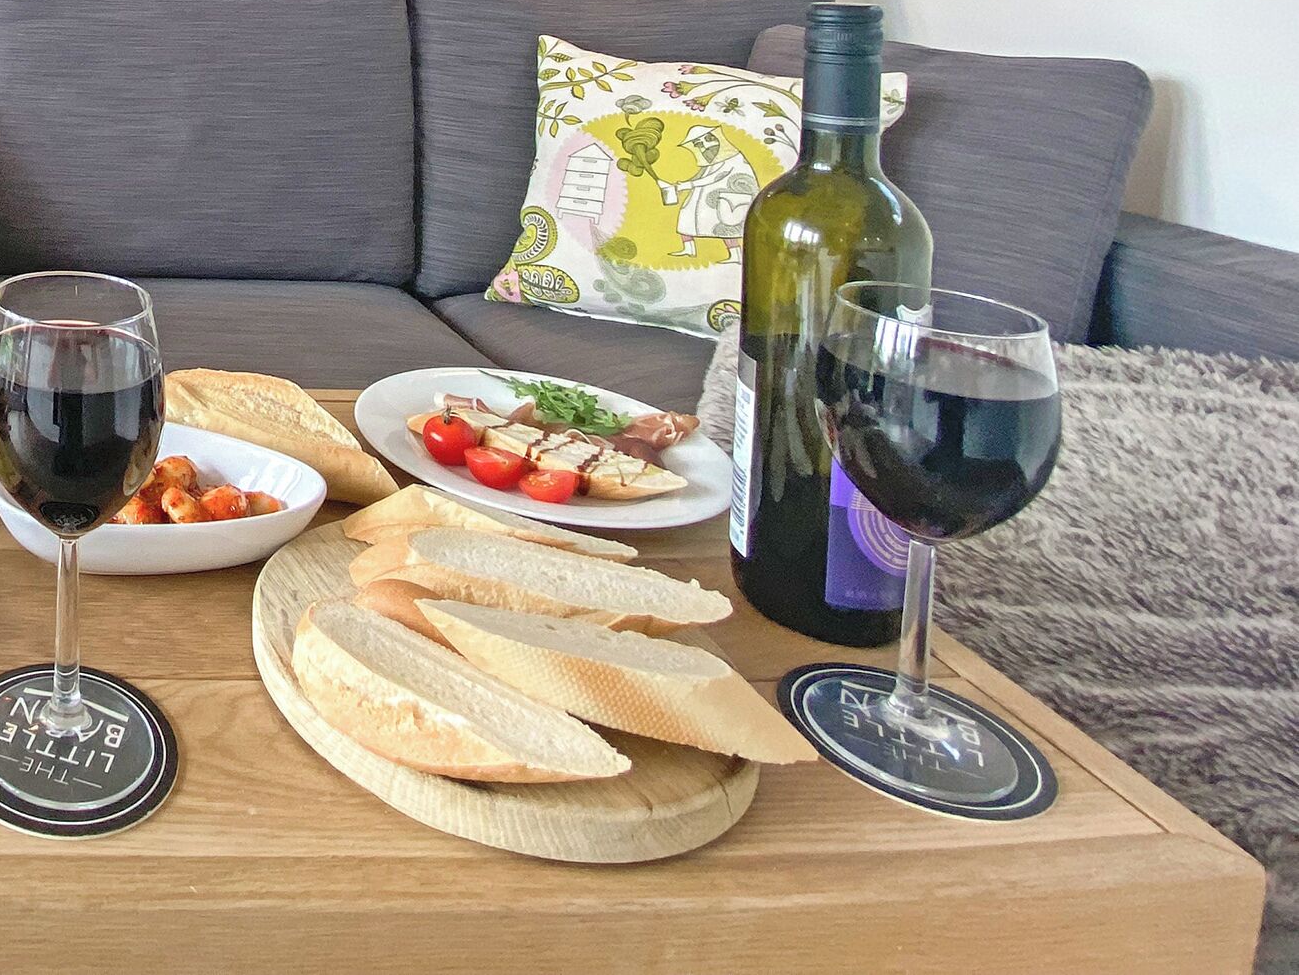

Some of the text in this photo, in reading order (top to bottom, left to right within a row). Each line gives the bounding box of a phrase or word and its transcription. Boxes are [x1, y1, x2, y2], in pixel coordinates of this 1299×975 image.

[0, 721, 116, 774] LITTLE
[841, 709, 984, 767] LTTLE
[883, 743, 948, 773] THE
[19, 755, 70, 786] THE
